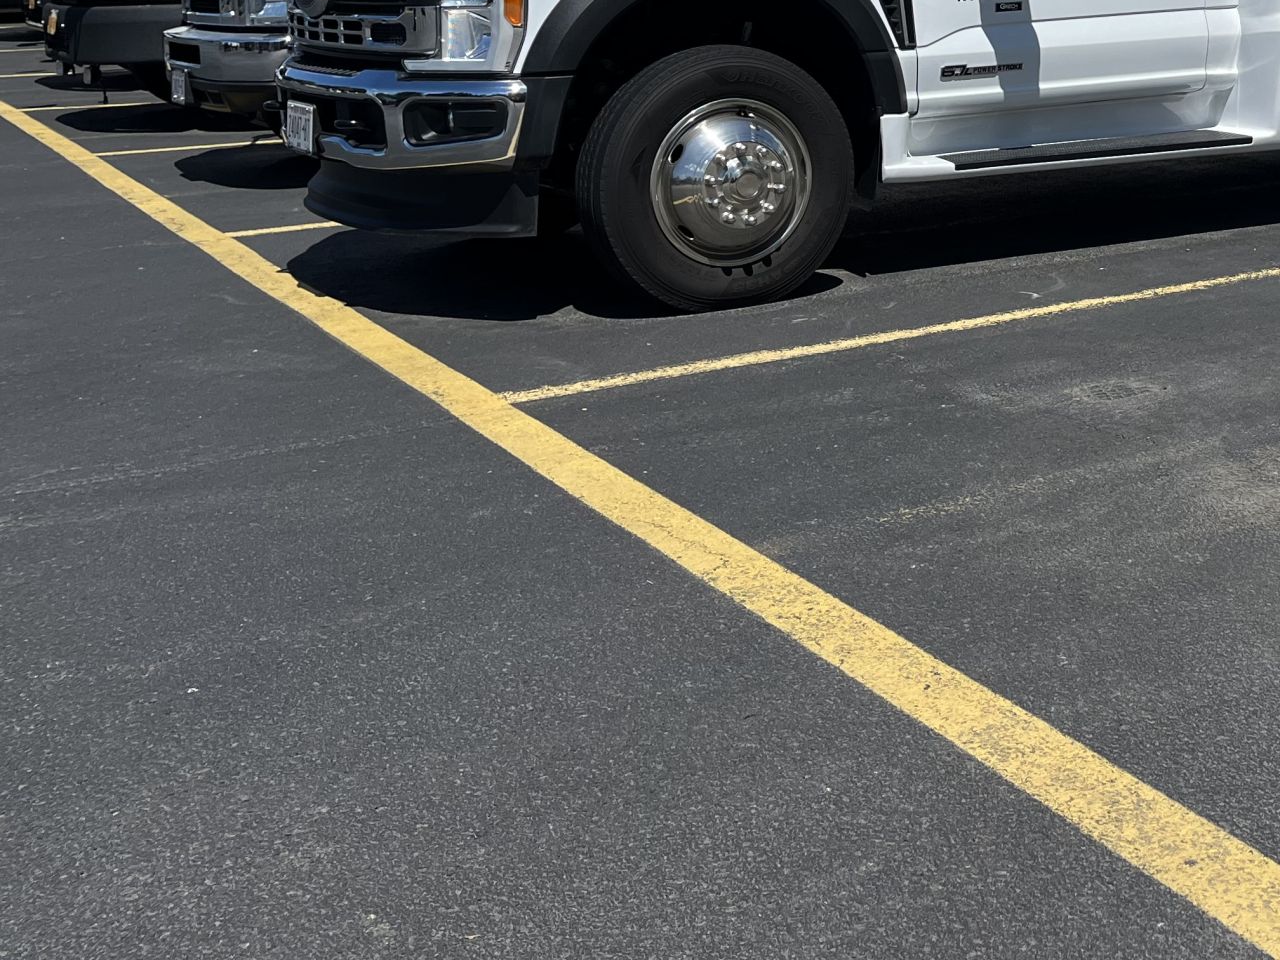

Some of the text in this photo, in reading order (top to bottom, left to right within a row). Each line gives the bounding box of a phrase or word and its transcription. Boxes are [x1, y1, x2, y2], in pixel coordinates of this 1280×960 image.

[941, 63, 1024, 78] 6.7L POWER STROKE
